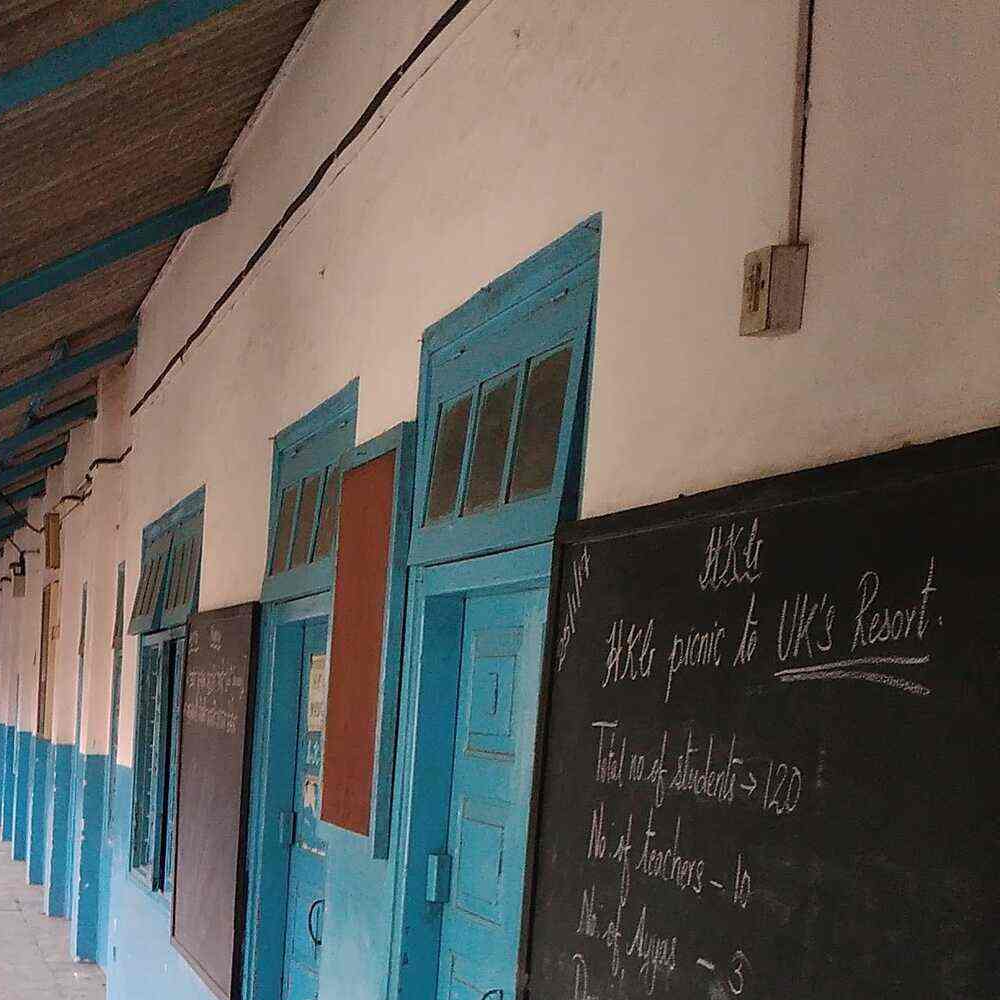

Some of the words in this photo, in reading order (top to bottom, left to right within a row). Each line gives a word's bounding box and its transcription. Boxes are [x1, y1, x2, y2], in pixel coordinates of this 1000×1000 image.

[665, 620, 726, 703] picnic
[733, 592, 758, 667] to
[669, 732, 744, 801] students
[636, 806, 705, 894] teachers
